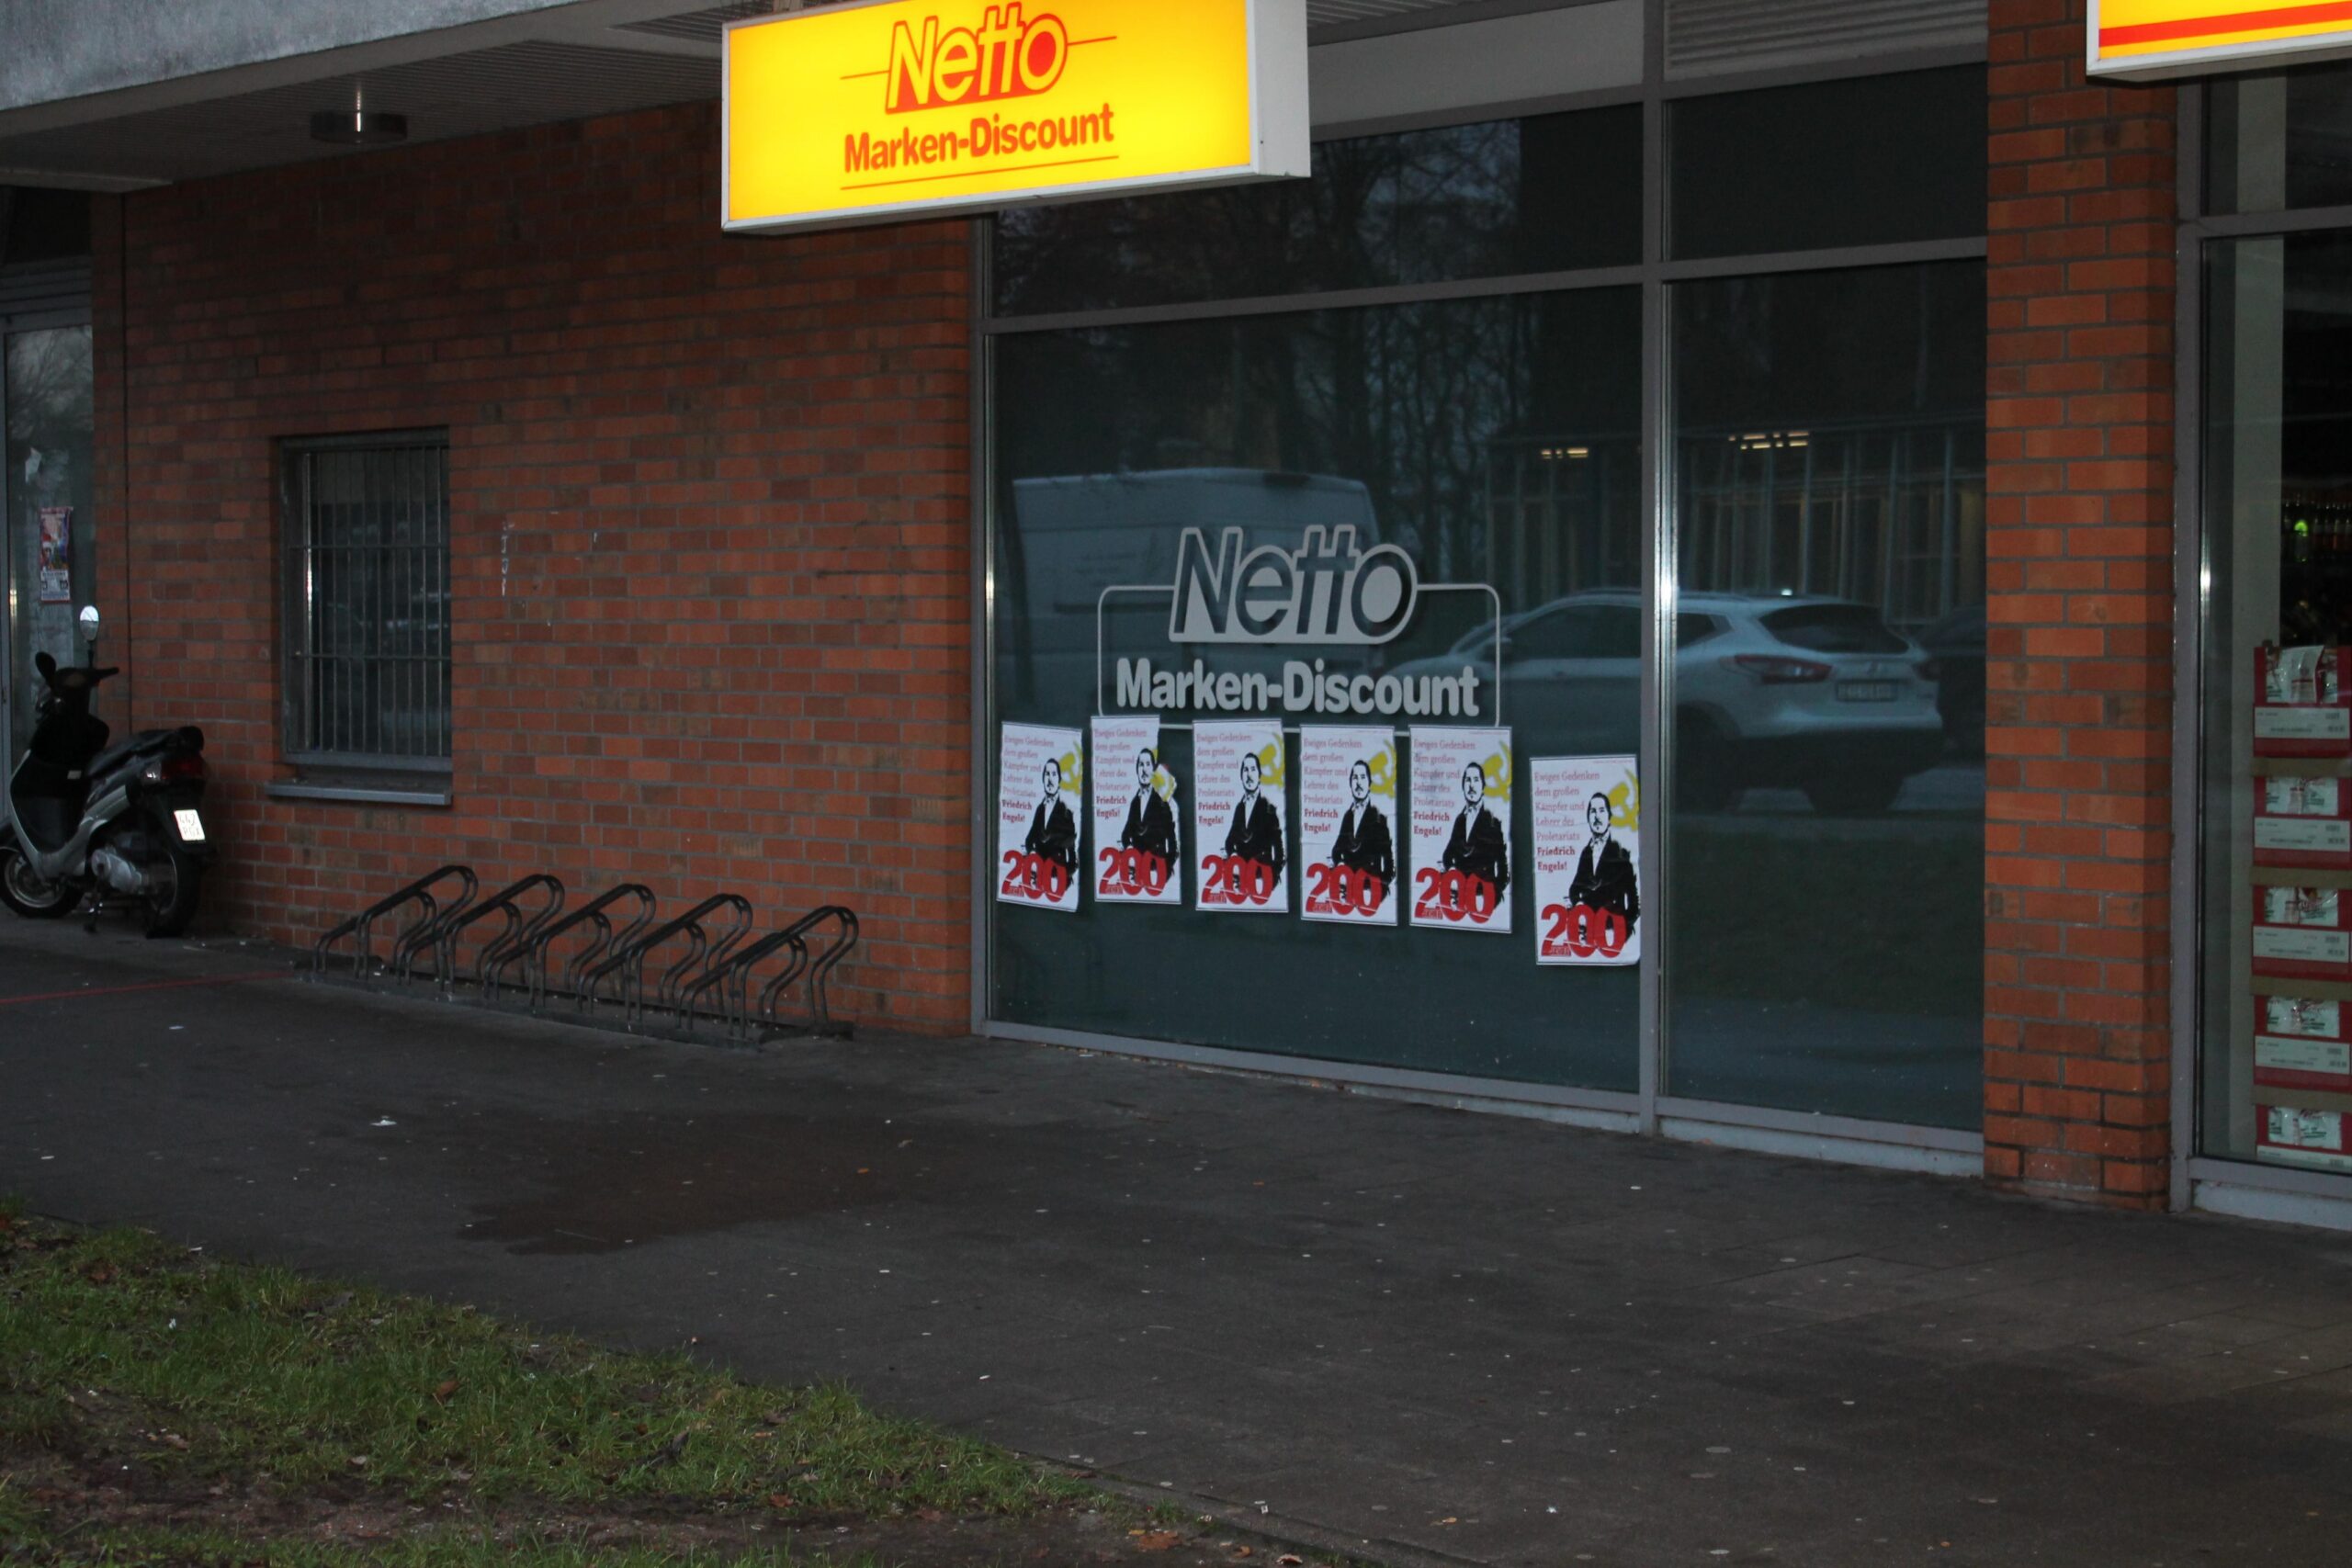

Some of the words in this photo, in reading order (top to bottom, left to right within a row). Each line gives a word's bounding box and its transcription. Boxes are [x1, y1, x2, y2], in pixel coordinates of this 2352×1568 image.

[885, 1, 1069, 115] Netto
[844, 103, 1114, 174] Marken-Discount
[1169, 524, 1418, 644] Netto
[1116, 658, 1480, 716] Marken-Discount
[1002, 799, 1032, 810] Friedrich
[1096, 795, 1126, 804] Friedrich
[1198, 802, 1230, 811] Friedrich
[1304, 808, 1339, 818] Friedrich
[1413, 811, 1450, 821] Friedrich
[1413, 826, 1442, 837] Engels!
[1537, 846, 1576, 856] Friedrich
[1001, 850, 1068, 902] 200
[1099, 847, 1167, 896] 200
[1202, 854, 1274, 905] 200
[1306, 863, 1382, 917] 200
[1537, 861, 1567, 873] Engels!
[1415, 867, 1495, 923] 200
[1541, 904, 1628, 958] 200
